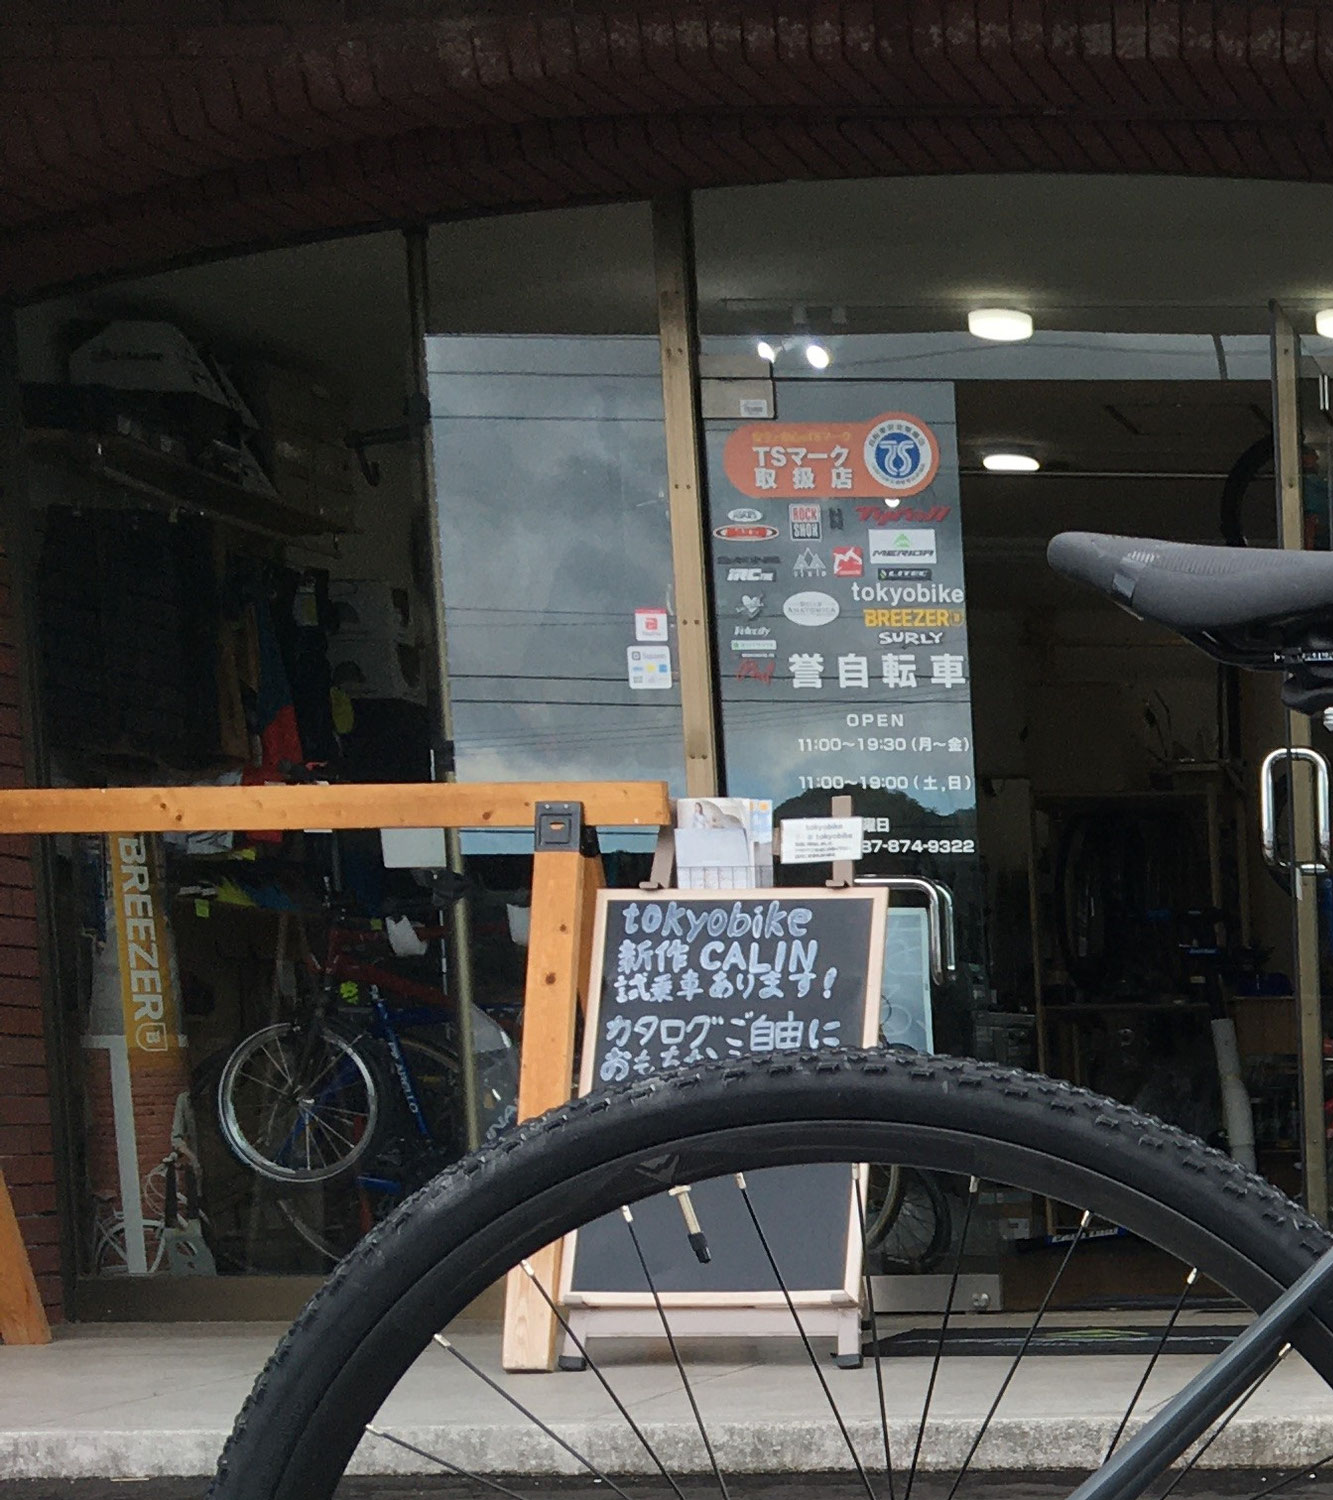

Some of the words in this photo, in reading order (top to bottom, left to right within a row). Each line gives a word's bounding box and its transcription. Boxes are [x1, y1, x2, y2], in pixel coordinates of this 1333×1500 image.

[752, 445, 850, 468] TSマーク
[754, 467, 853, 490] 取扱店
[792, 507, 818, 521] ROCK
[871, 549, 935, 558] MERIDA
[851, 581, 965, 607] tokyobike
[863, 608, 950, 628] BREEZER
[878, 631, 944, 646] SURLY
[788, 652, 967, 690] 誉自転車
[846, 713, 905, 727] OPEN
[117, 834, 165, 1022] BREEZER
[622, 900, 813, 943] tokyobike
[617, 939, 690, 974] 新作
[699, 939, 819, 974] CALIN
